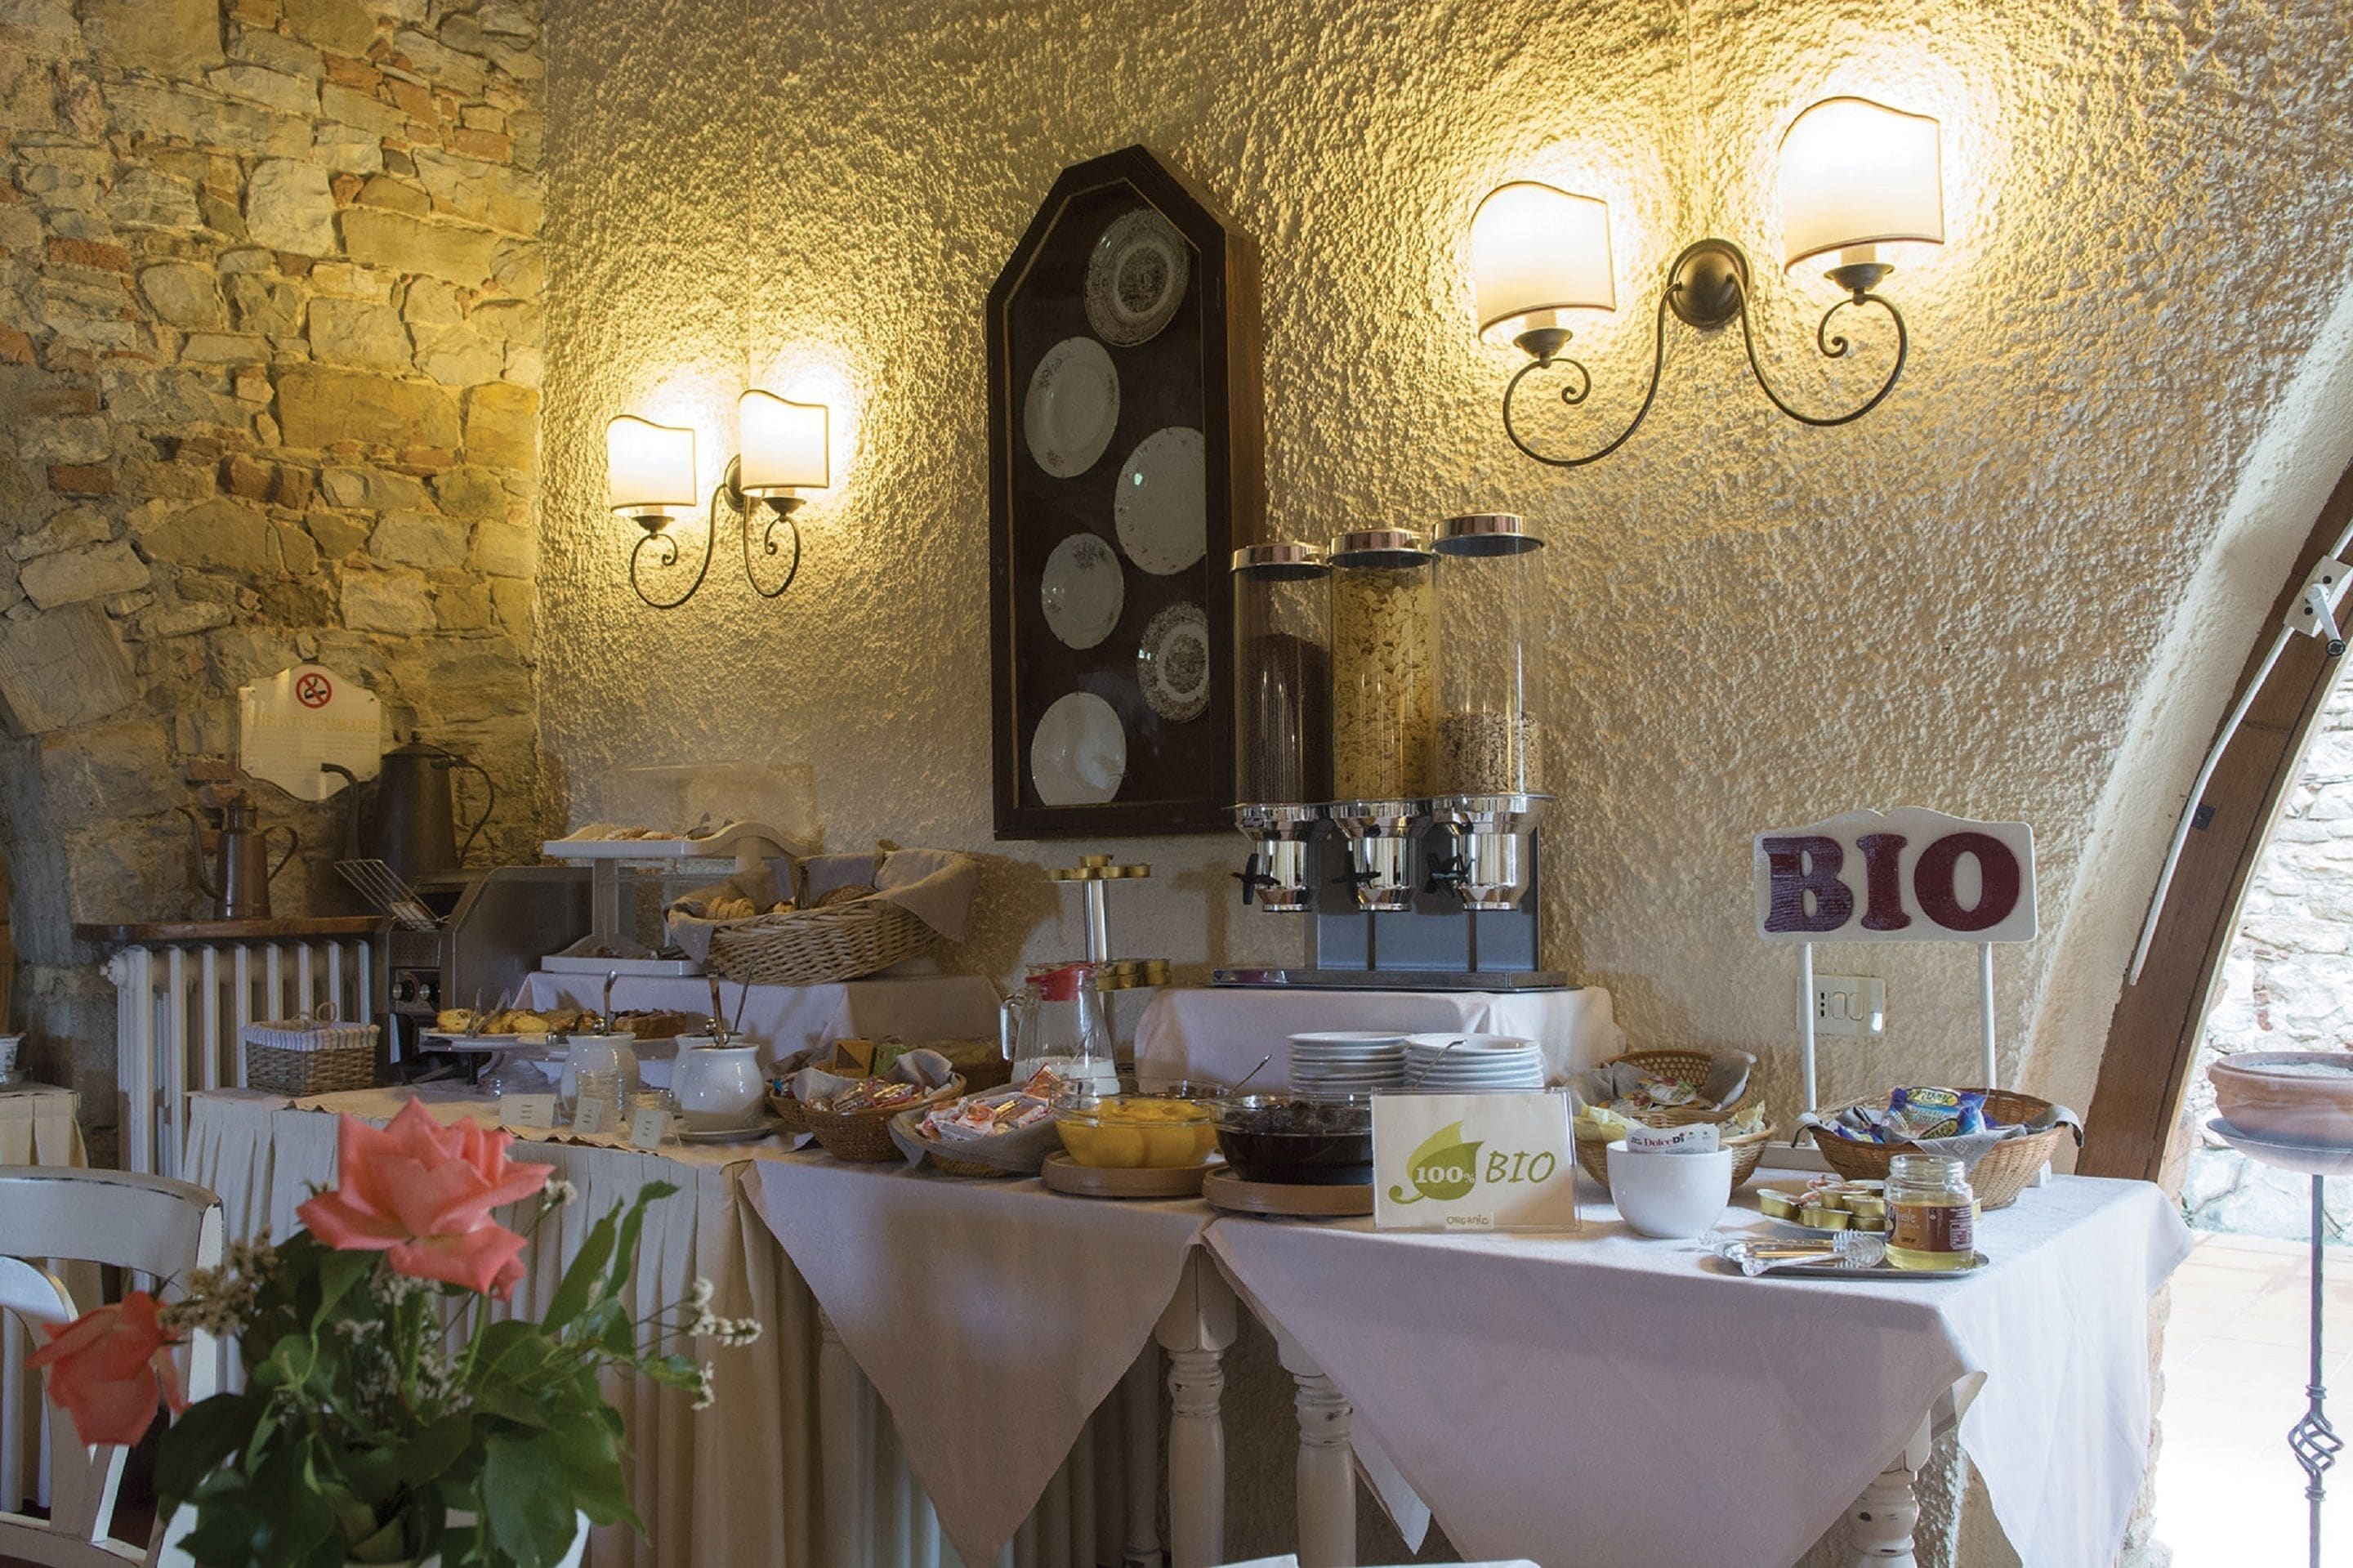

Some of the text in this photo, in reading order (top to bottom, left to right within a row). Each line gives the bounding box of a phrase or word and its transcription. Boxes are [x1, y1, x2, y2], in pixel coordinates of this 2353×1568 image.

[1761, 831, 2020, 932] BIO
[1415, 1150, 1556, 1184] 100% BIO
